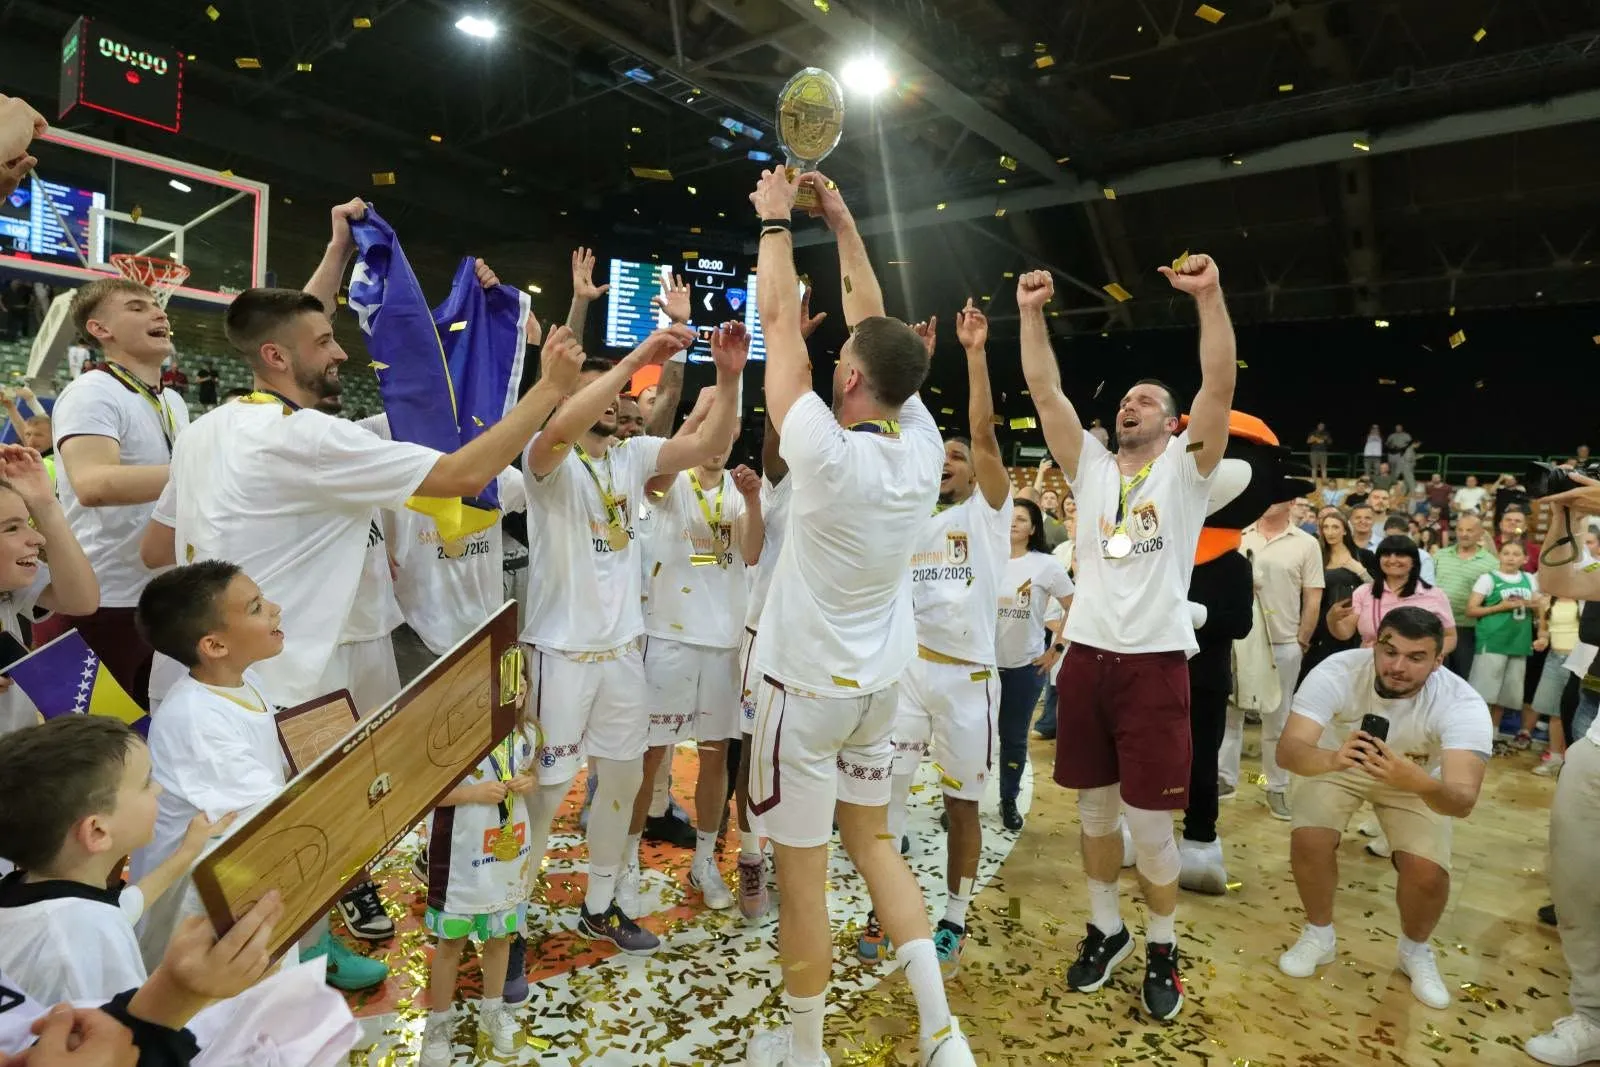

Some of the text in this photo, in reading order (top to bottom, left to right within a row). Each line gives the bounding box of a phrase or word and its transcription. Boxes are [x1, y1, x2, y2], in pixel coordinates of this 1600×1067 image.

[99, 37, 168, 75] 00:00
[698, 258, 724, 271] 00:00
[912, 566, 972, 582] 2025/2026
[997, 608, 1031, 620] 25/2026
